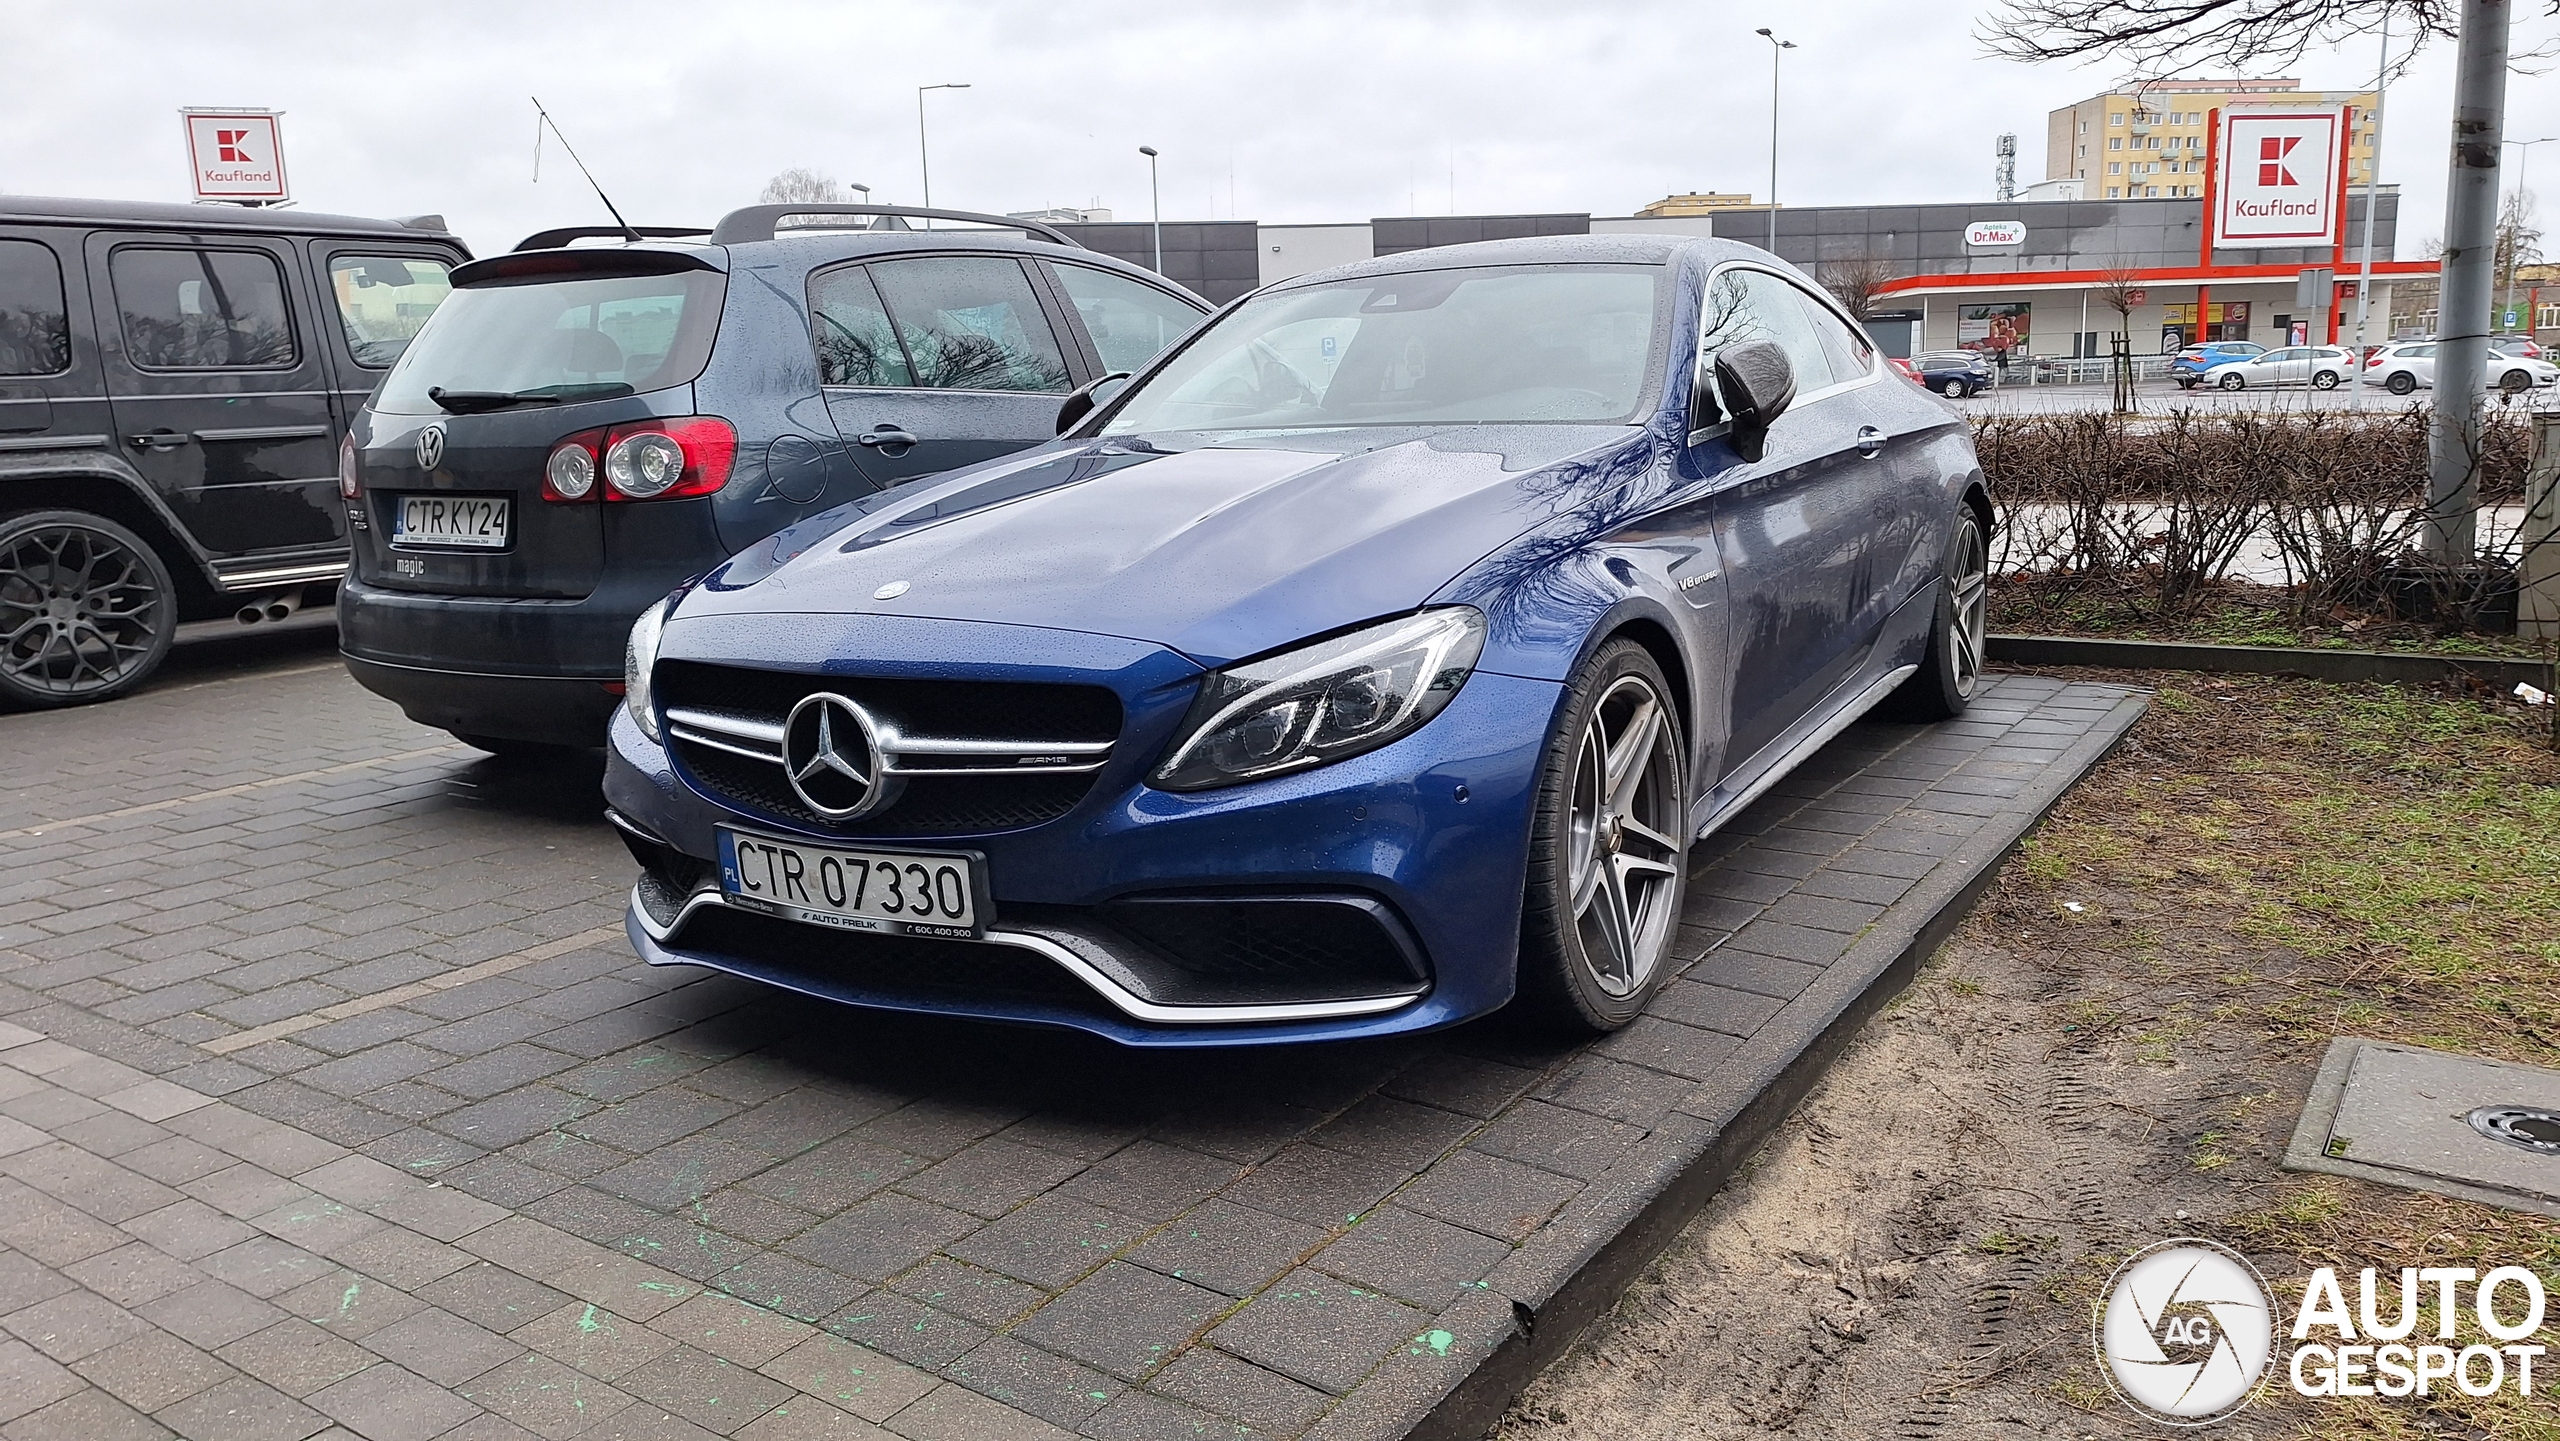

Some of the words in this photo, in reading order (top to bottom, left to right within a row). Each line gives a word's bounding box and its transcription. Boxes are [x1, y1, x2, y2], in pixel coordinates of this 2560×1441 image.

[205, 170, 272, 182] Kaufland
[2235, 199, 2318, 217] Kaufland
[1983, 223, 2007, 231] Apteka
[406, 500, 445, 533] CTR
[450, 501, 506, 537] KY24
[396, 556, 425, 577] magic
[1678, 576, 1694, 592] V8
[724, 866, 738, 883] PL
[737, 840, 811, 903] CTR
[819, 855, 965, 920] 07330
[734, 895, 774, 913] Mercedes-Benz
[811, 914, 840, 926] AUTO
[914, 925, 933, 935] 600
[933, 927, 952, 936] 400
[952, 928, 971, 938] 900
